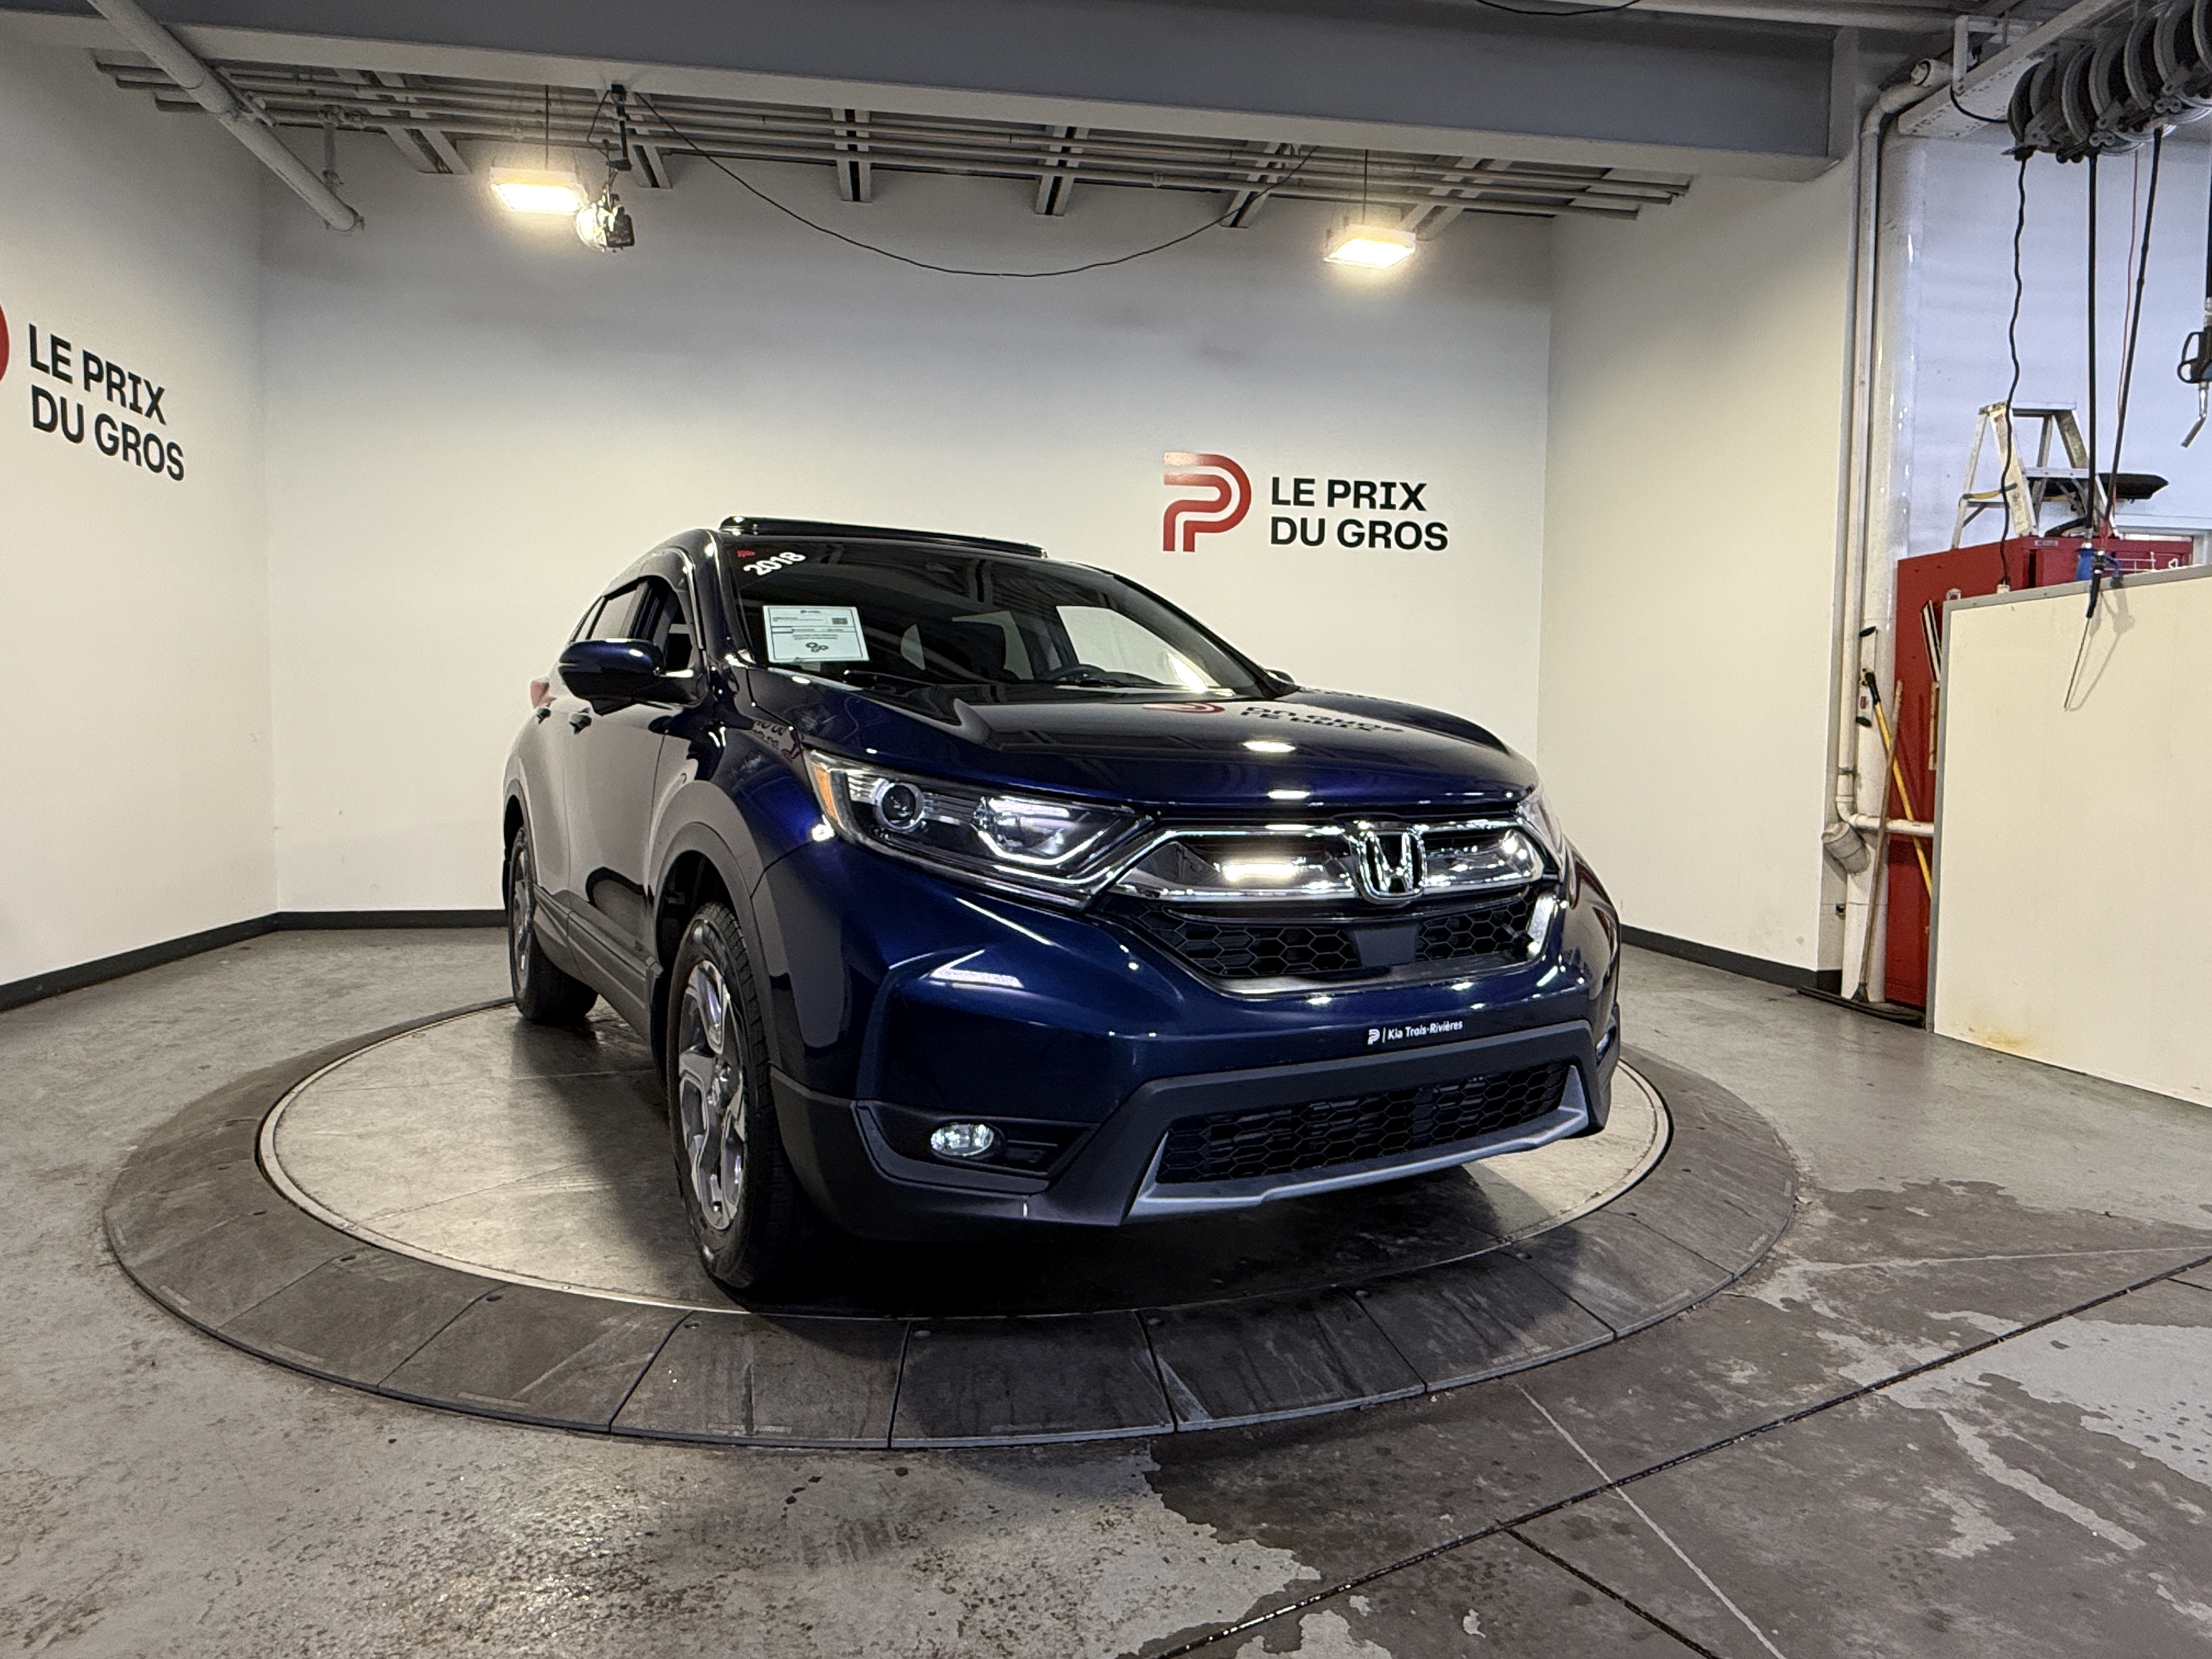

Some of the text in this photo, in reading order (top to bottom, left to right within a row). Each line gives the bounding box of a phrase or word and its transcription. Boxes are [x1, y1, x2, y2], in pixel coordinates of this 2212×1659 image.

[29, 323, 167, 426] LE PRIX
[31, 384, 184, 482] DU GROS
[1271, 476, 1427, 511] LE PRIX
[1271, 516, 1448, 551] DU GROS
[743, 551, 806, 576] 2018
[1387, 1028, 1403, 1040] Kia
[1404, 1020, 1464, 1038] Trois-Rivières
